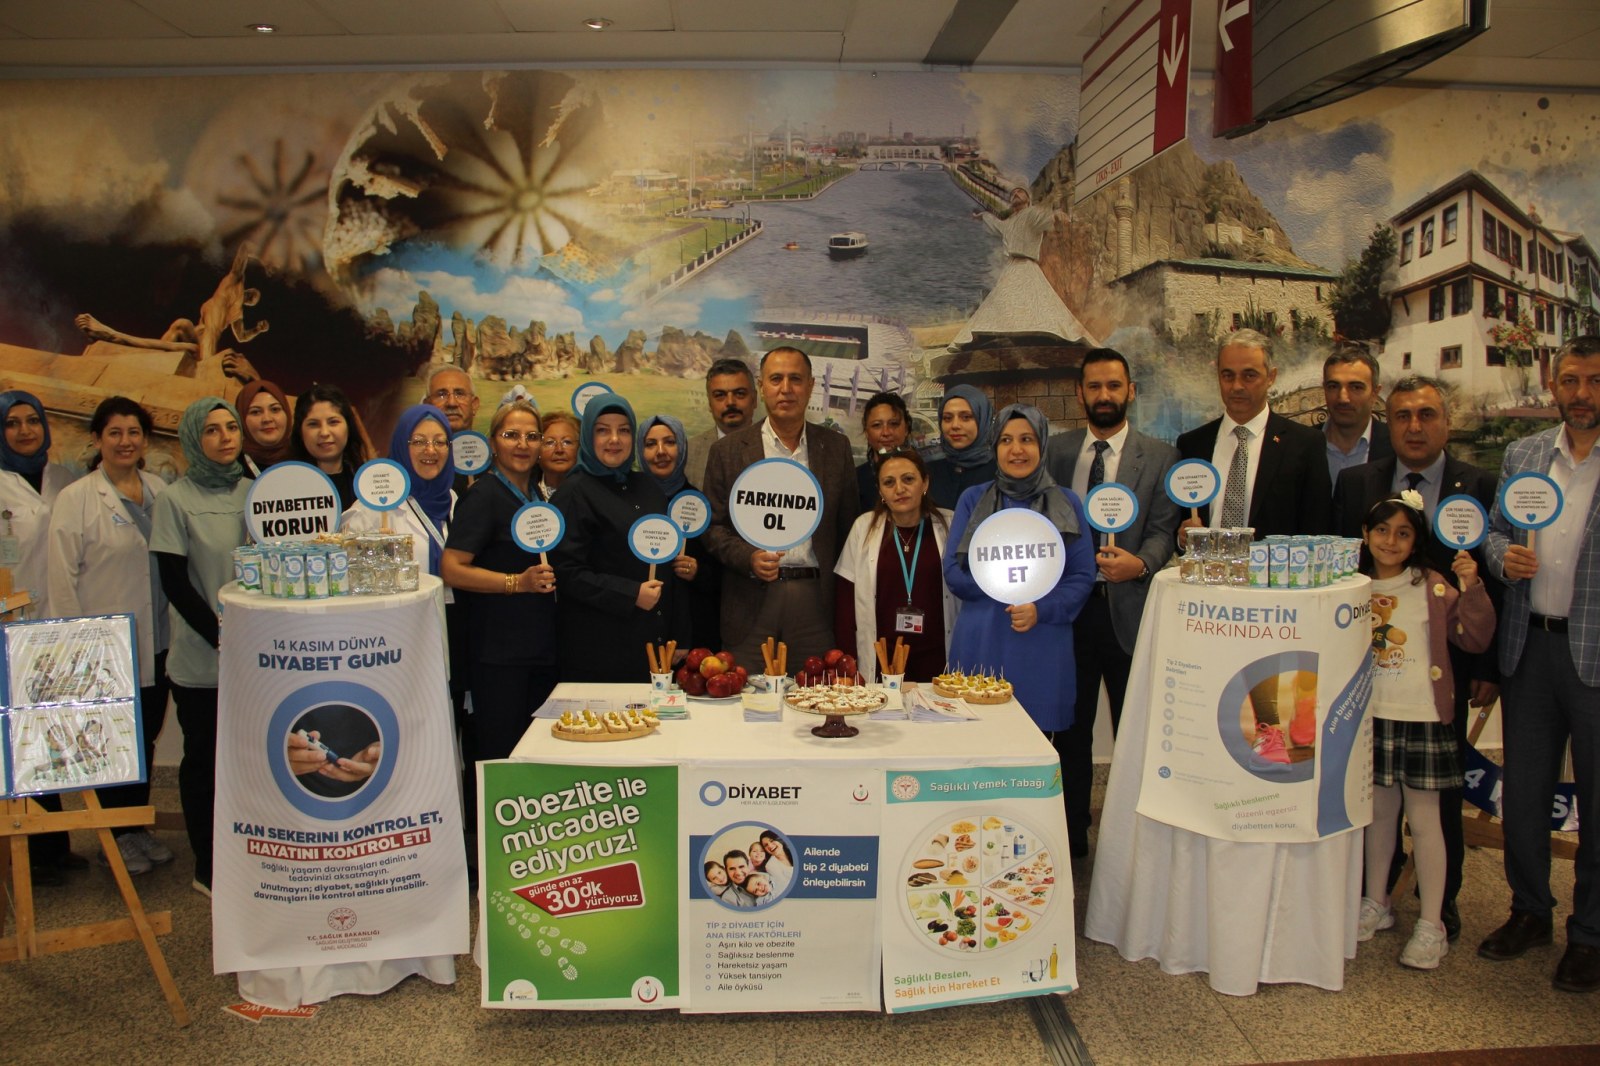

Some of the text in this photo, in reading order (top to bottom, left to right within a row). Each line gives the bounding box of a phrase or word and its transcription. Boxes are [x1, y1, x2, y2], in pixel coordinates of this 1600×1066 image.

[1111, 157, 1123, 175] EXIT
[736, 490, 816, 511] FARKINDA
[262, 516, 328, 538] KORUN
[764, 513, 786, 530] OL
[977, 542, 1057, 562] HAREKET
[1008, 566, 1028, 583] ET
[1178, 600, 1297, 623] #DİYABETİN
[1186, 619, 1301, 640] FARKINDA OL
[273, 636, 386, 652] 14 KASIM DÜNYA
[728, 784, 802, 799] DİYABET
[930, 778, 1045, 793] Sağlıklı Yemek Tabağı
[495, 778, 647, 826] Obezite ile
[1214, 792, 1280, 810] Sağlıklı beslenme
[1235, 805, 1297, 819] düzenli egzersiz
[233, 821, 264, 837] KAN
[344, 815, 417, 842] KONTROL
[420, 810, 443, 826] ET,
[502, 804, 640, 854] mücadele
[1232, 822, 1273, 831] diyabetten
[250, 831, 429, 860] HAYATINI KONTROL ET!
[509, 828, 638, 879] ediyoruz!
[804, 847, 840, 857] Ailende
[261, 853, 418, 876] Sağlıklı yaşam davranışları edinin ve
[803, 863, 869, 873] tip 2 diyabeti
[260, 873, 421, 894] Unutmayın; diyabet, sağlıklı yaşam
[289, 868, 389, 882] tedavinizi aksatmayın.
[803, 878, 866, 888] önleyebilirsin
[254, 880, 429, 904] davranışları ile kontrol altına alınabilir.
[529, 877, 583, 898] günde en az
[585, 894, 638, 909] yürüyoruz
[345, 930, 380, 938] BAKANLIĞI
[767, 921, 784, 930] İÇİN
[726, 931, 746, 939] RİSK
[748, 930, 801, 938] FAKTÖRLERİ
[718, 952, 754, 960] Sağlıksız
[761, 962, 788, 970] yaşam
[718, 972, 782, 981] Yüksek tansiyon
[894, 970, 971, 986] Sağlıklı Beslen,
[734, 984, 763, 992] öyküsü
[895, 977, 1000, 999] Sağlık İçin Hareket Et
